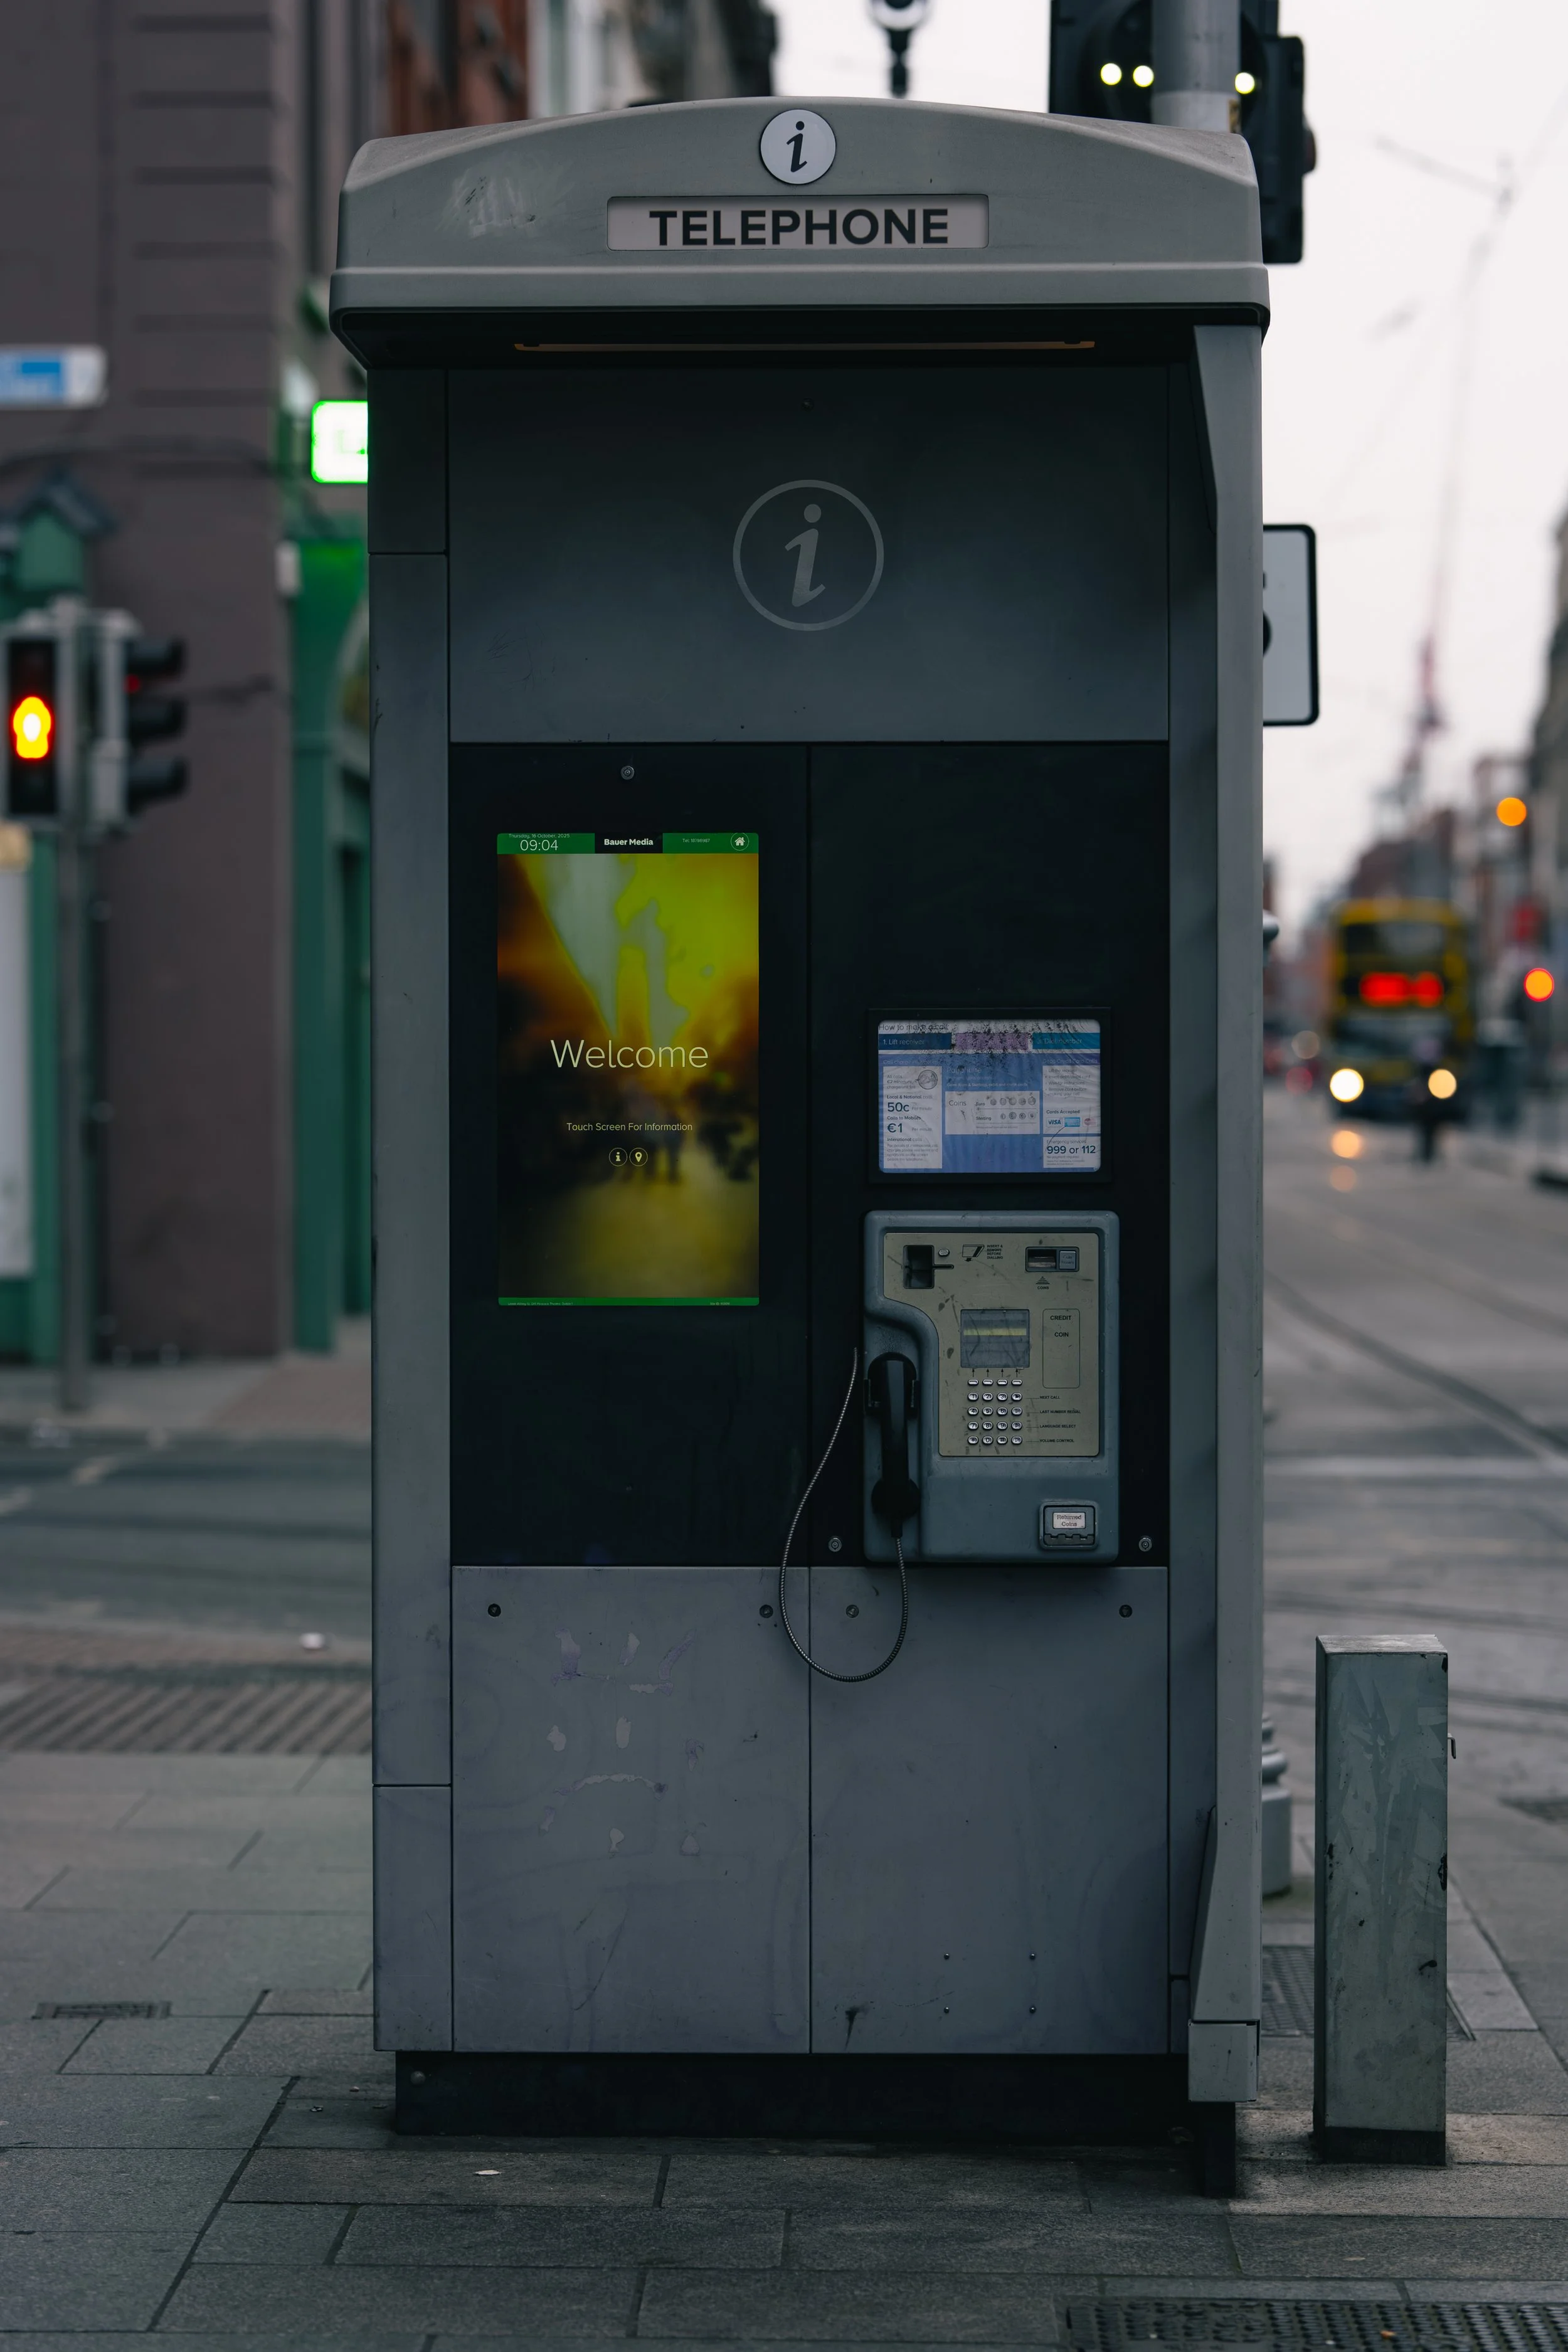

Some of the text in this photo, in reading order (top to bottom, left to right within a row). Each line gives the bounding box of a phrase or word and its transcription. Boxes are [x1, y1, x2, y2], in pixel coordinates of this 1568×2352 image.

[649, 209, 948, 246] TELEPHONE
[521, 839, 558, 850] 09:04
[551, 1040, 709, 1067] Welcome
[887, 1102, 909, 1111] 50c
[566, 1123, 692, 1131] Touch Screen For Information
[887, 1123, 902, 1133] €1
[1047, 1146, 1066, 1154] 999
[1082, 1145, 1096, 1153] 112
